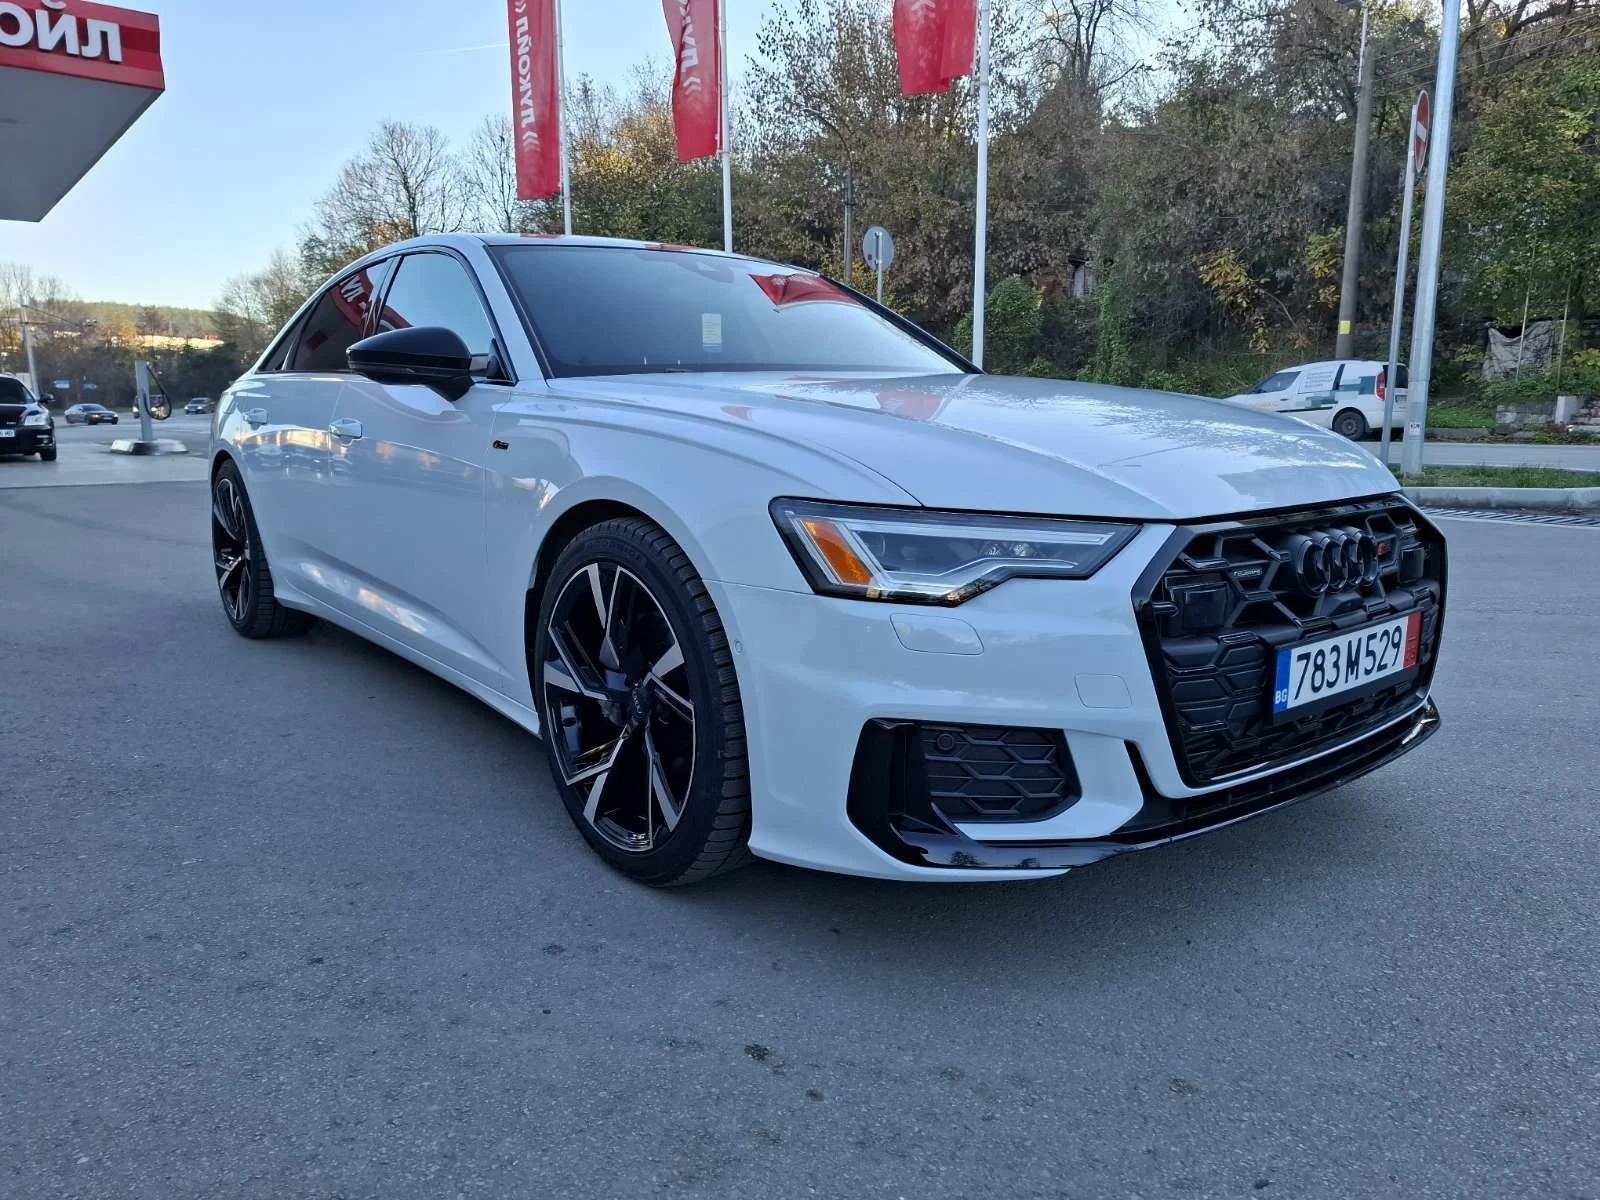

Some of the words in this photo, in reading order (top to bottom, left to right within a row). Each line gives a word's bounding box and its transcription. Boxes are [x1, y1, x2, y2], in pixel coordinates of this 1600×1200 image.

[0, 0, 122, 62] ОЙЛ
[1294, 625, 1403, 701] 783M529
[1274, 688, 1288, 705] BG
